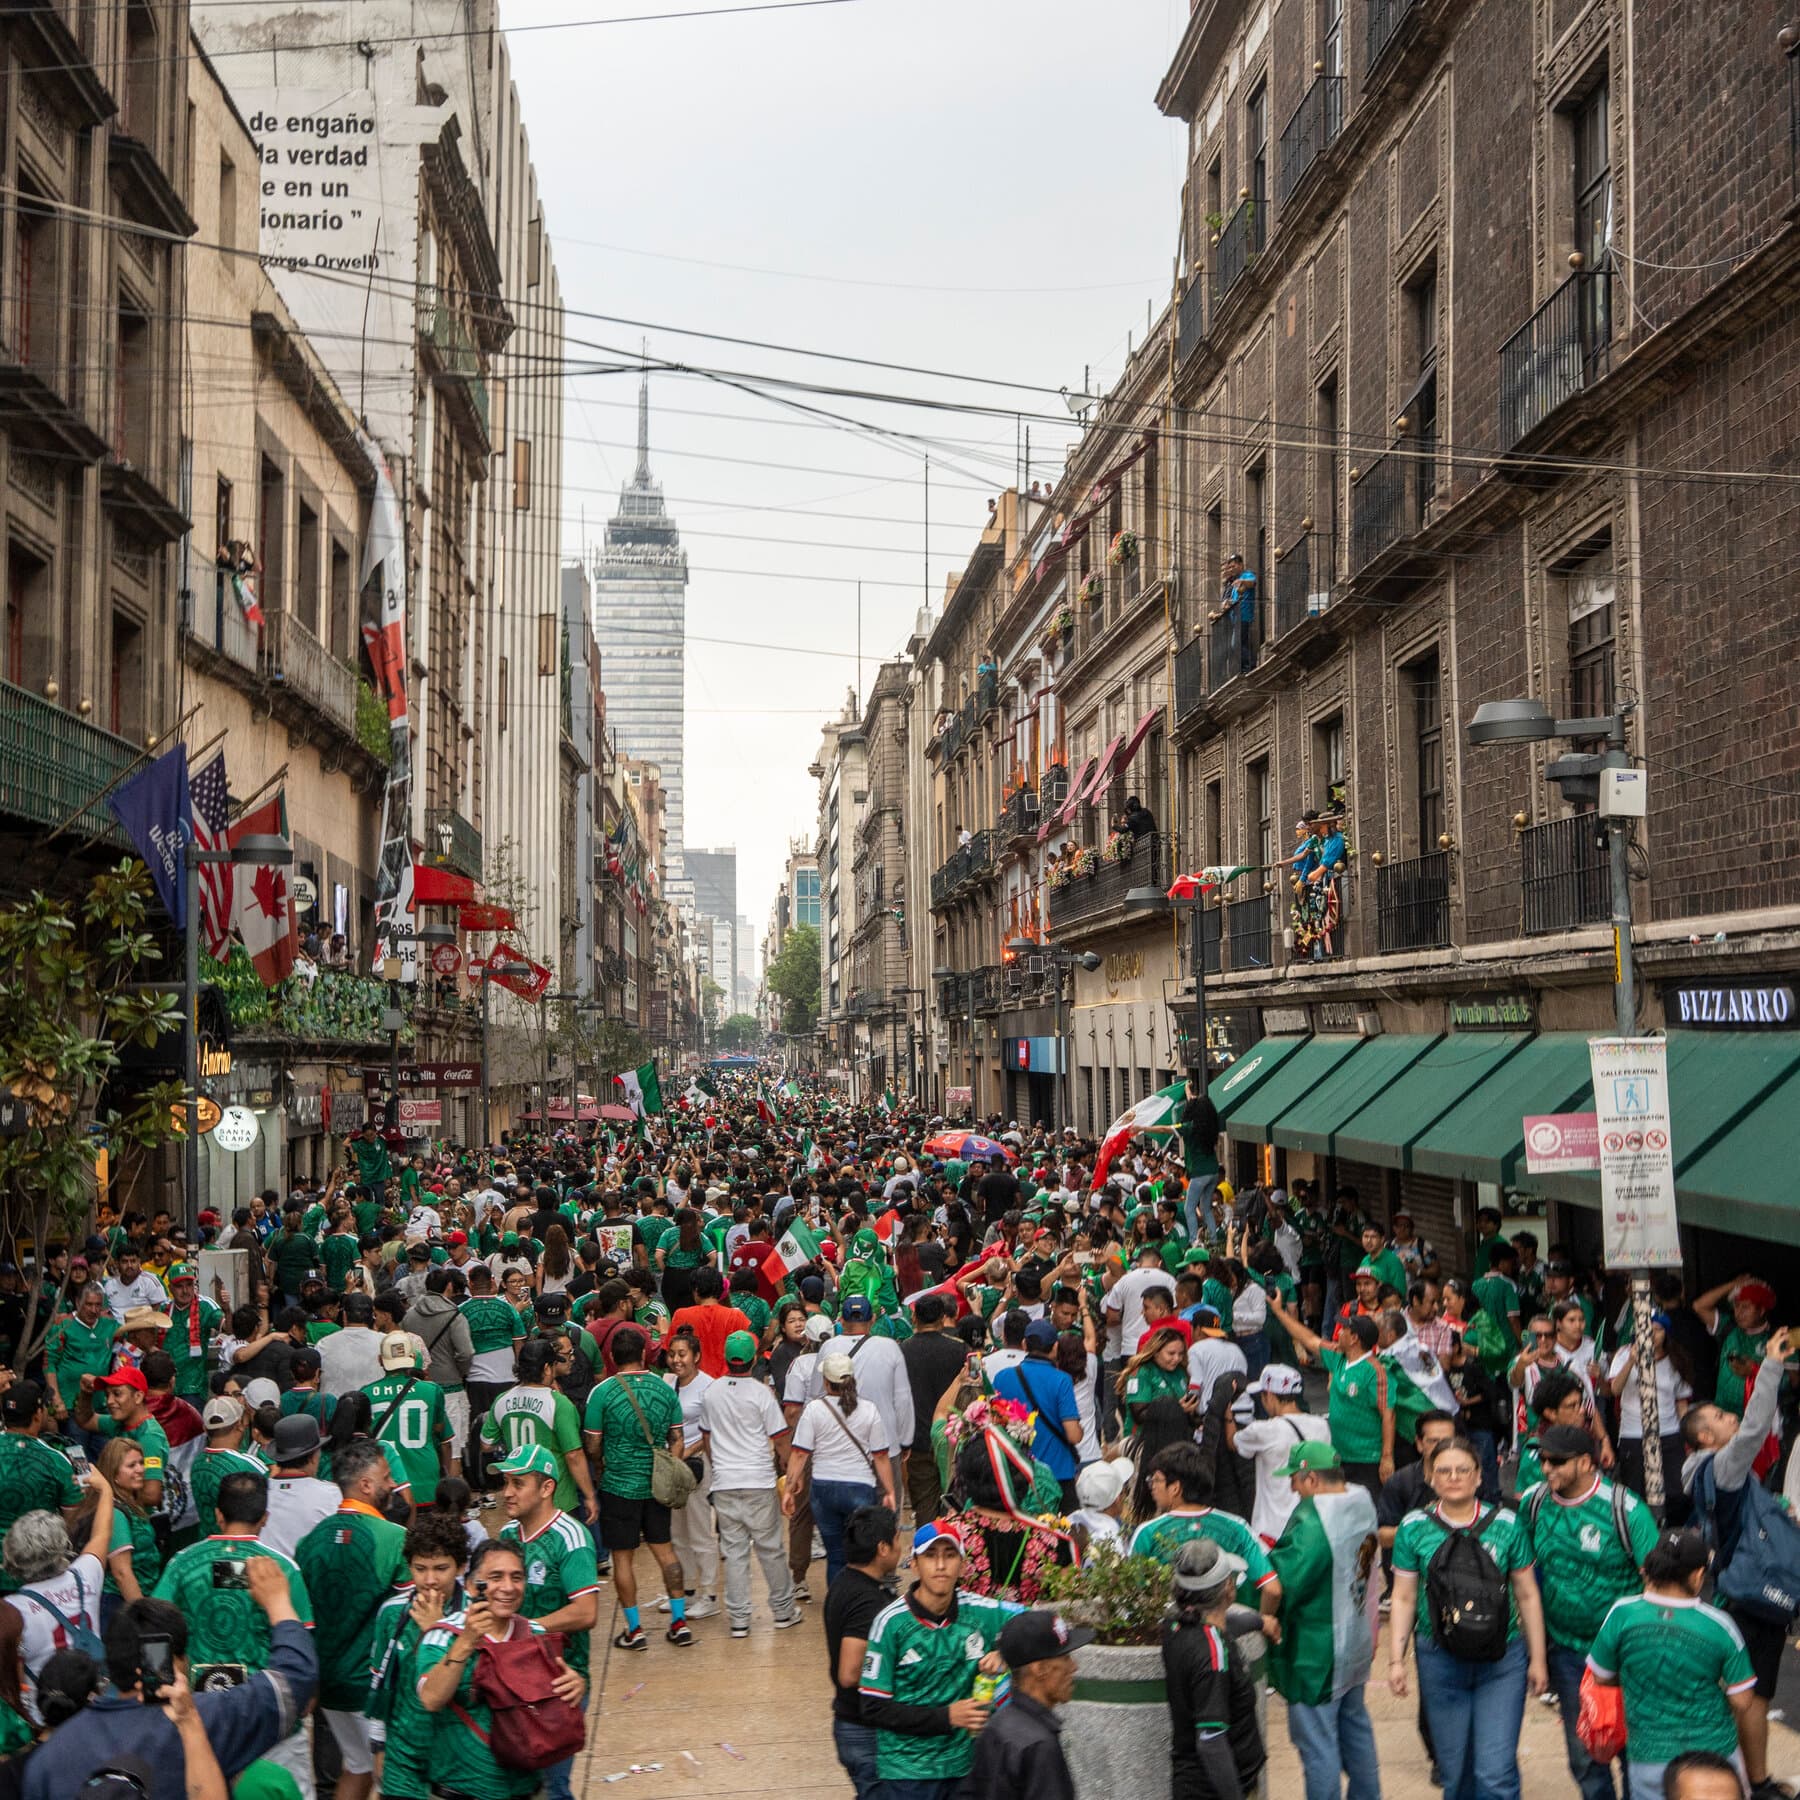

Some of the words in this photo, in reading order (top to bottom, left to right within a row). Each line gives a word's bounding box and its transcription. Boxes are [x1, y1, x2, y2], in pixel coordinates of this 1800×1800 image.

[249, 111, 278, 133] de
[286, 113, 375, 139] engaño
[288, 145, 368, 167] verdad
[284, 181, 312, 197] en
[321, 182, 349, 198] un
[260, 208, 343, 230] ionario
[1678, 987, 1788, 1022] BIZZARRO
[201, 1041, 231, 1077] Amorino
[218, 1135, 251, 1143] CLARA
[219, 1128, 251, 1137] SANTA
[505, 1396, 543, 1414] C.BLANCO
[509, 1416, 536, 1451] 10
